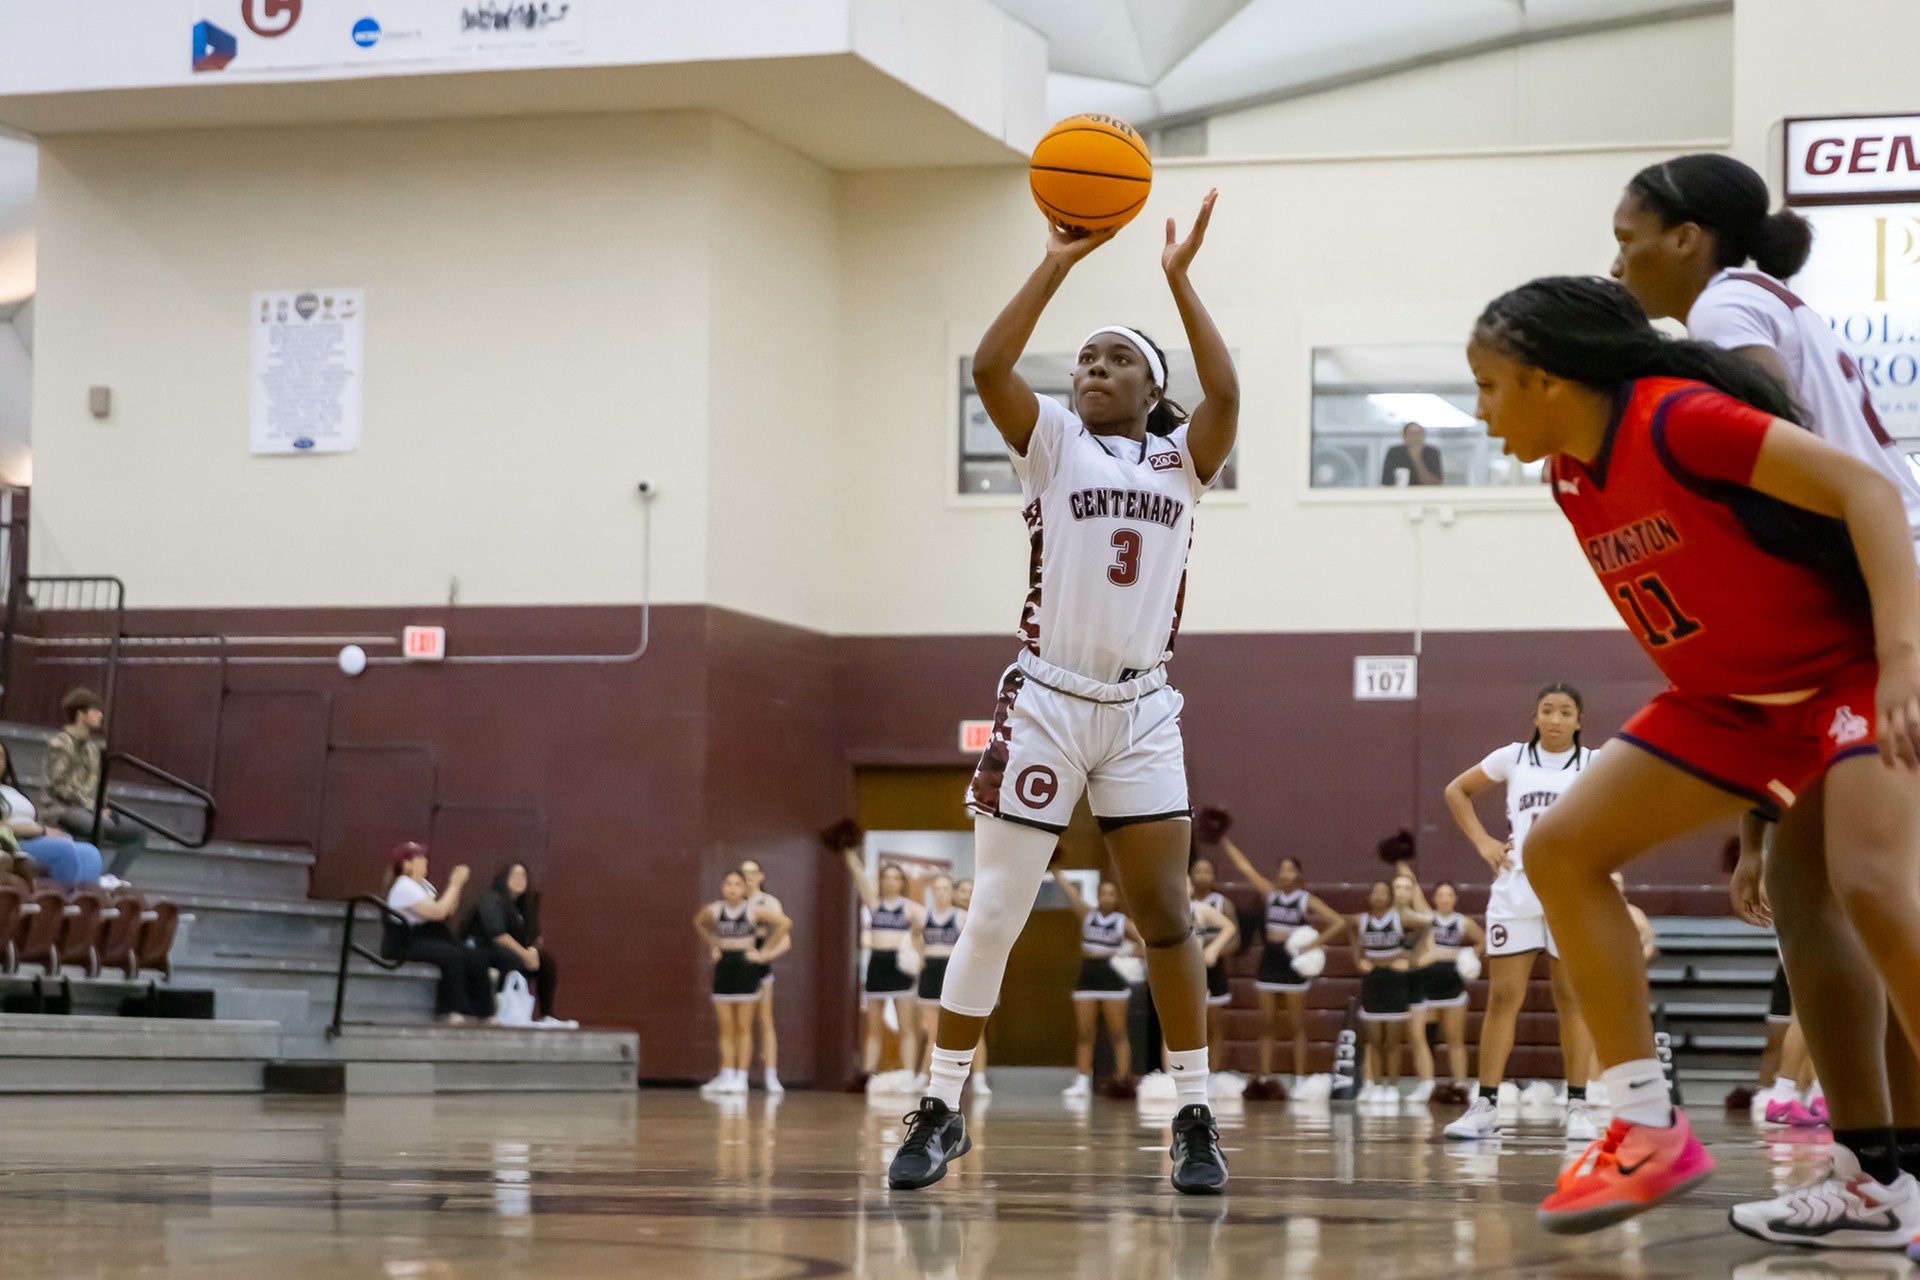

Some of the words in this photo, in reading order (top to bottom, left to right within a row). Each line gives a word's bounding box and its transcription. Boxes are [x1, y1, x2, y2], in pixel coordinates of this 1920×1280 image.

[1804, 135, 1920, 176] GEN
[1069, 487, 1185, 530] CENTENARY
[1107, 528, 1143, 586] 3
[1615, 572, 1706, 647] 11
[1366, 672, 1406, 691] 107
[1021, 770, 1053, 805] C
[1491, 925, 1507, 947] C
